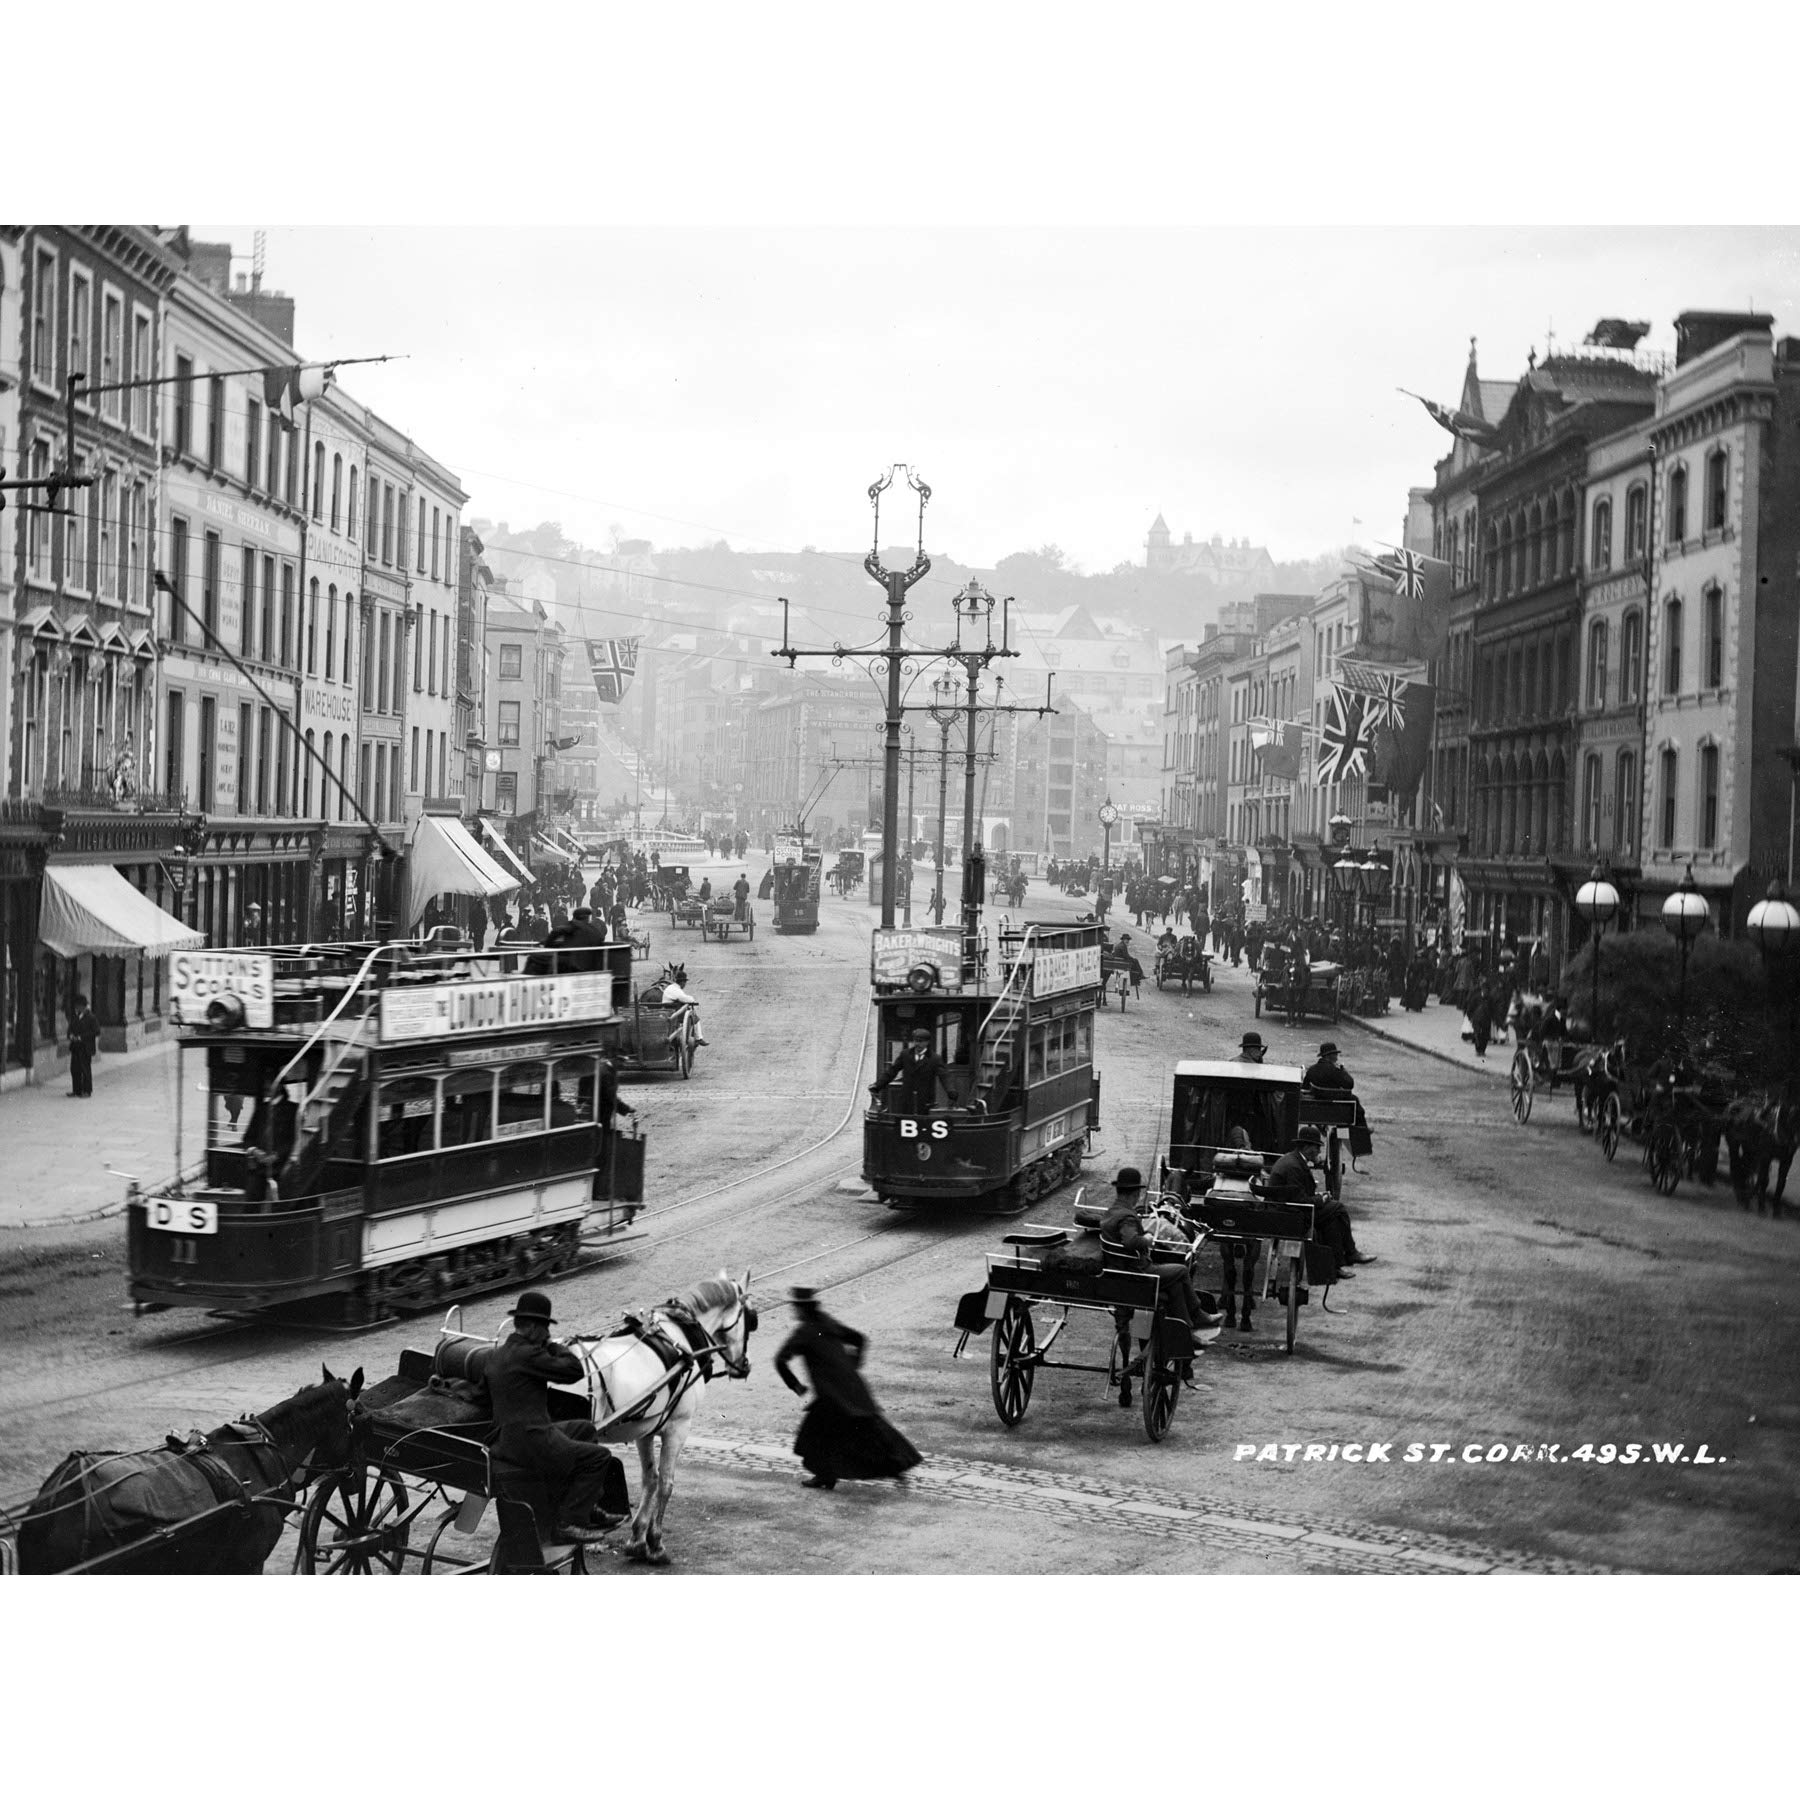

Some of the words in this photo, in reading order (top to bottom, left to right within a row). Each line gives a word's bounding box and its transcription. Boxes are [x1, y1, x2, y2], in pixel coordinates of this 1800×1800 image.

[304, 688, 352, 722] WAREHOUSE
[875, 934, 912, 952] BAKER
[194, 979, 264, 1000] COALS
[509, 982, 555, 1023] HOUSE
[916, 1142, 932, 1162] 9
[170, 1237, 198, 1265] 11
